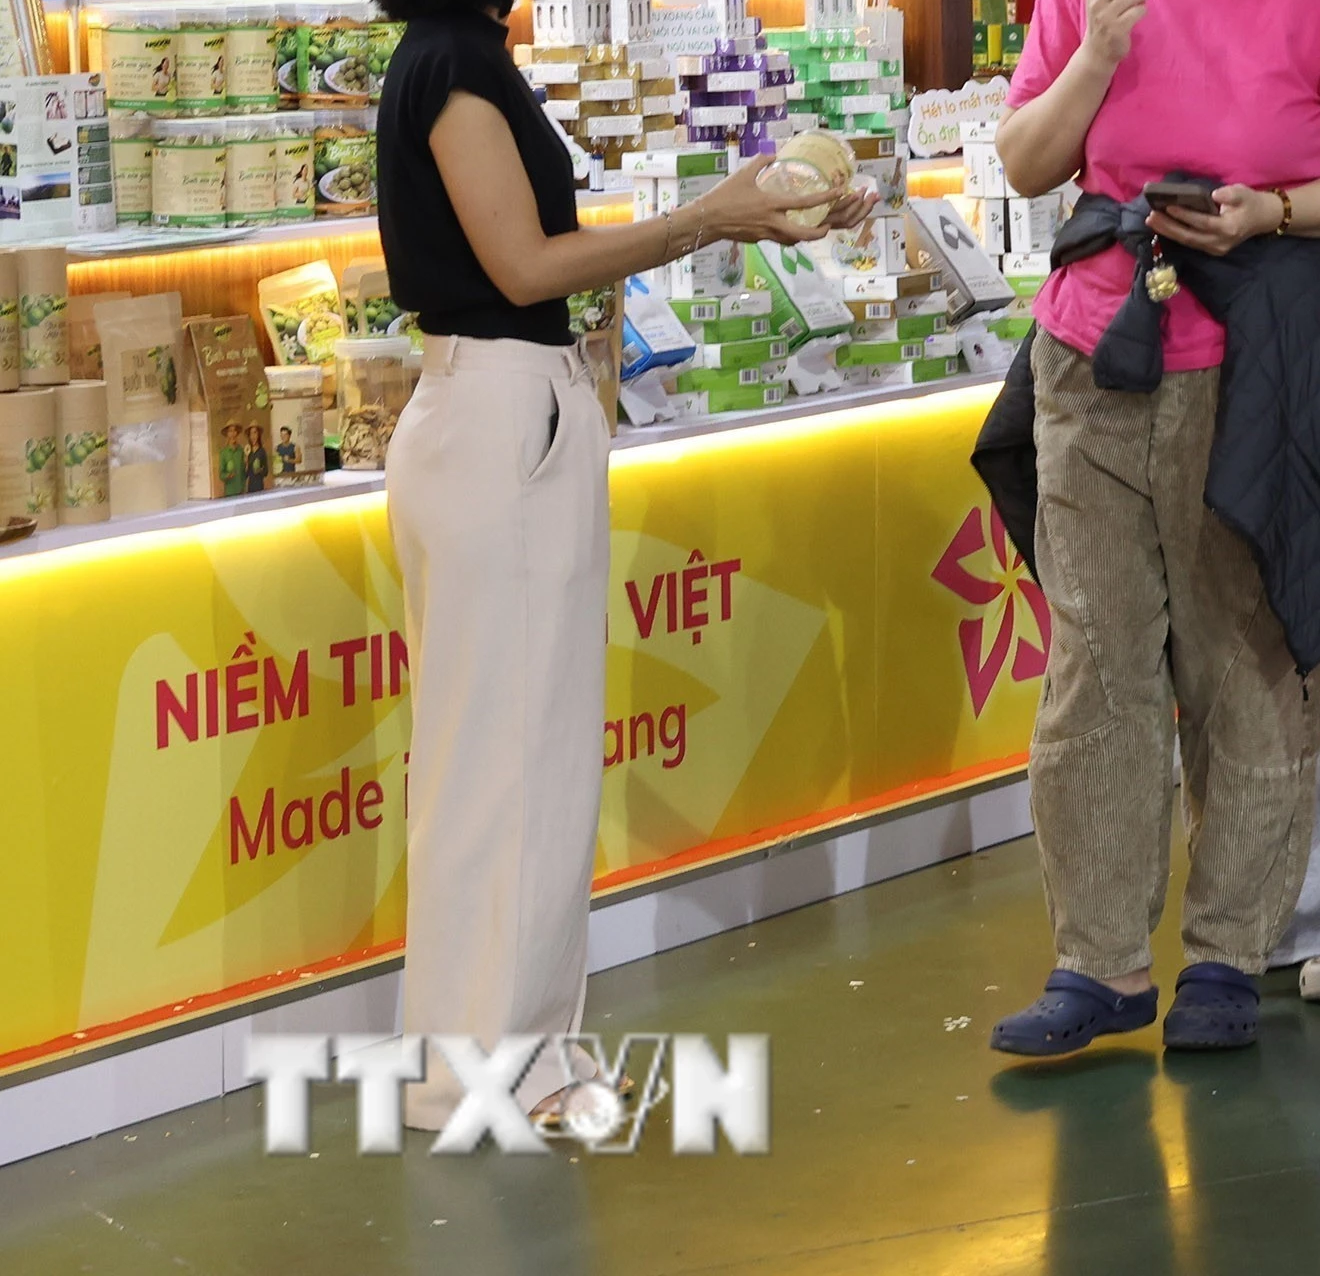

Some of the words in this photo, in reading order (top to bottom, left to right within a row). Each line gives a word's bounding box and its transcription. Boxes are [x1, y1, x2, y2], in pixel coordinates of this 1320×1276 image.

[920, 102, 942, 119] Hết
[945, 102, 957, 114] lo
[959, 91, 982, 110] mất
[156, 630, 310, 749] NIỀM
[625, 548, 742, 647] VIỆT
[228, 773, 384, 864] Made
